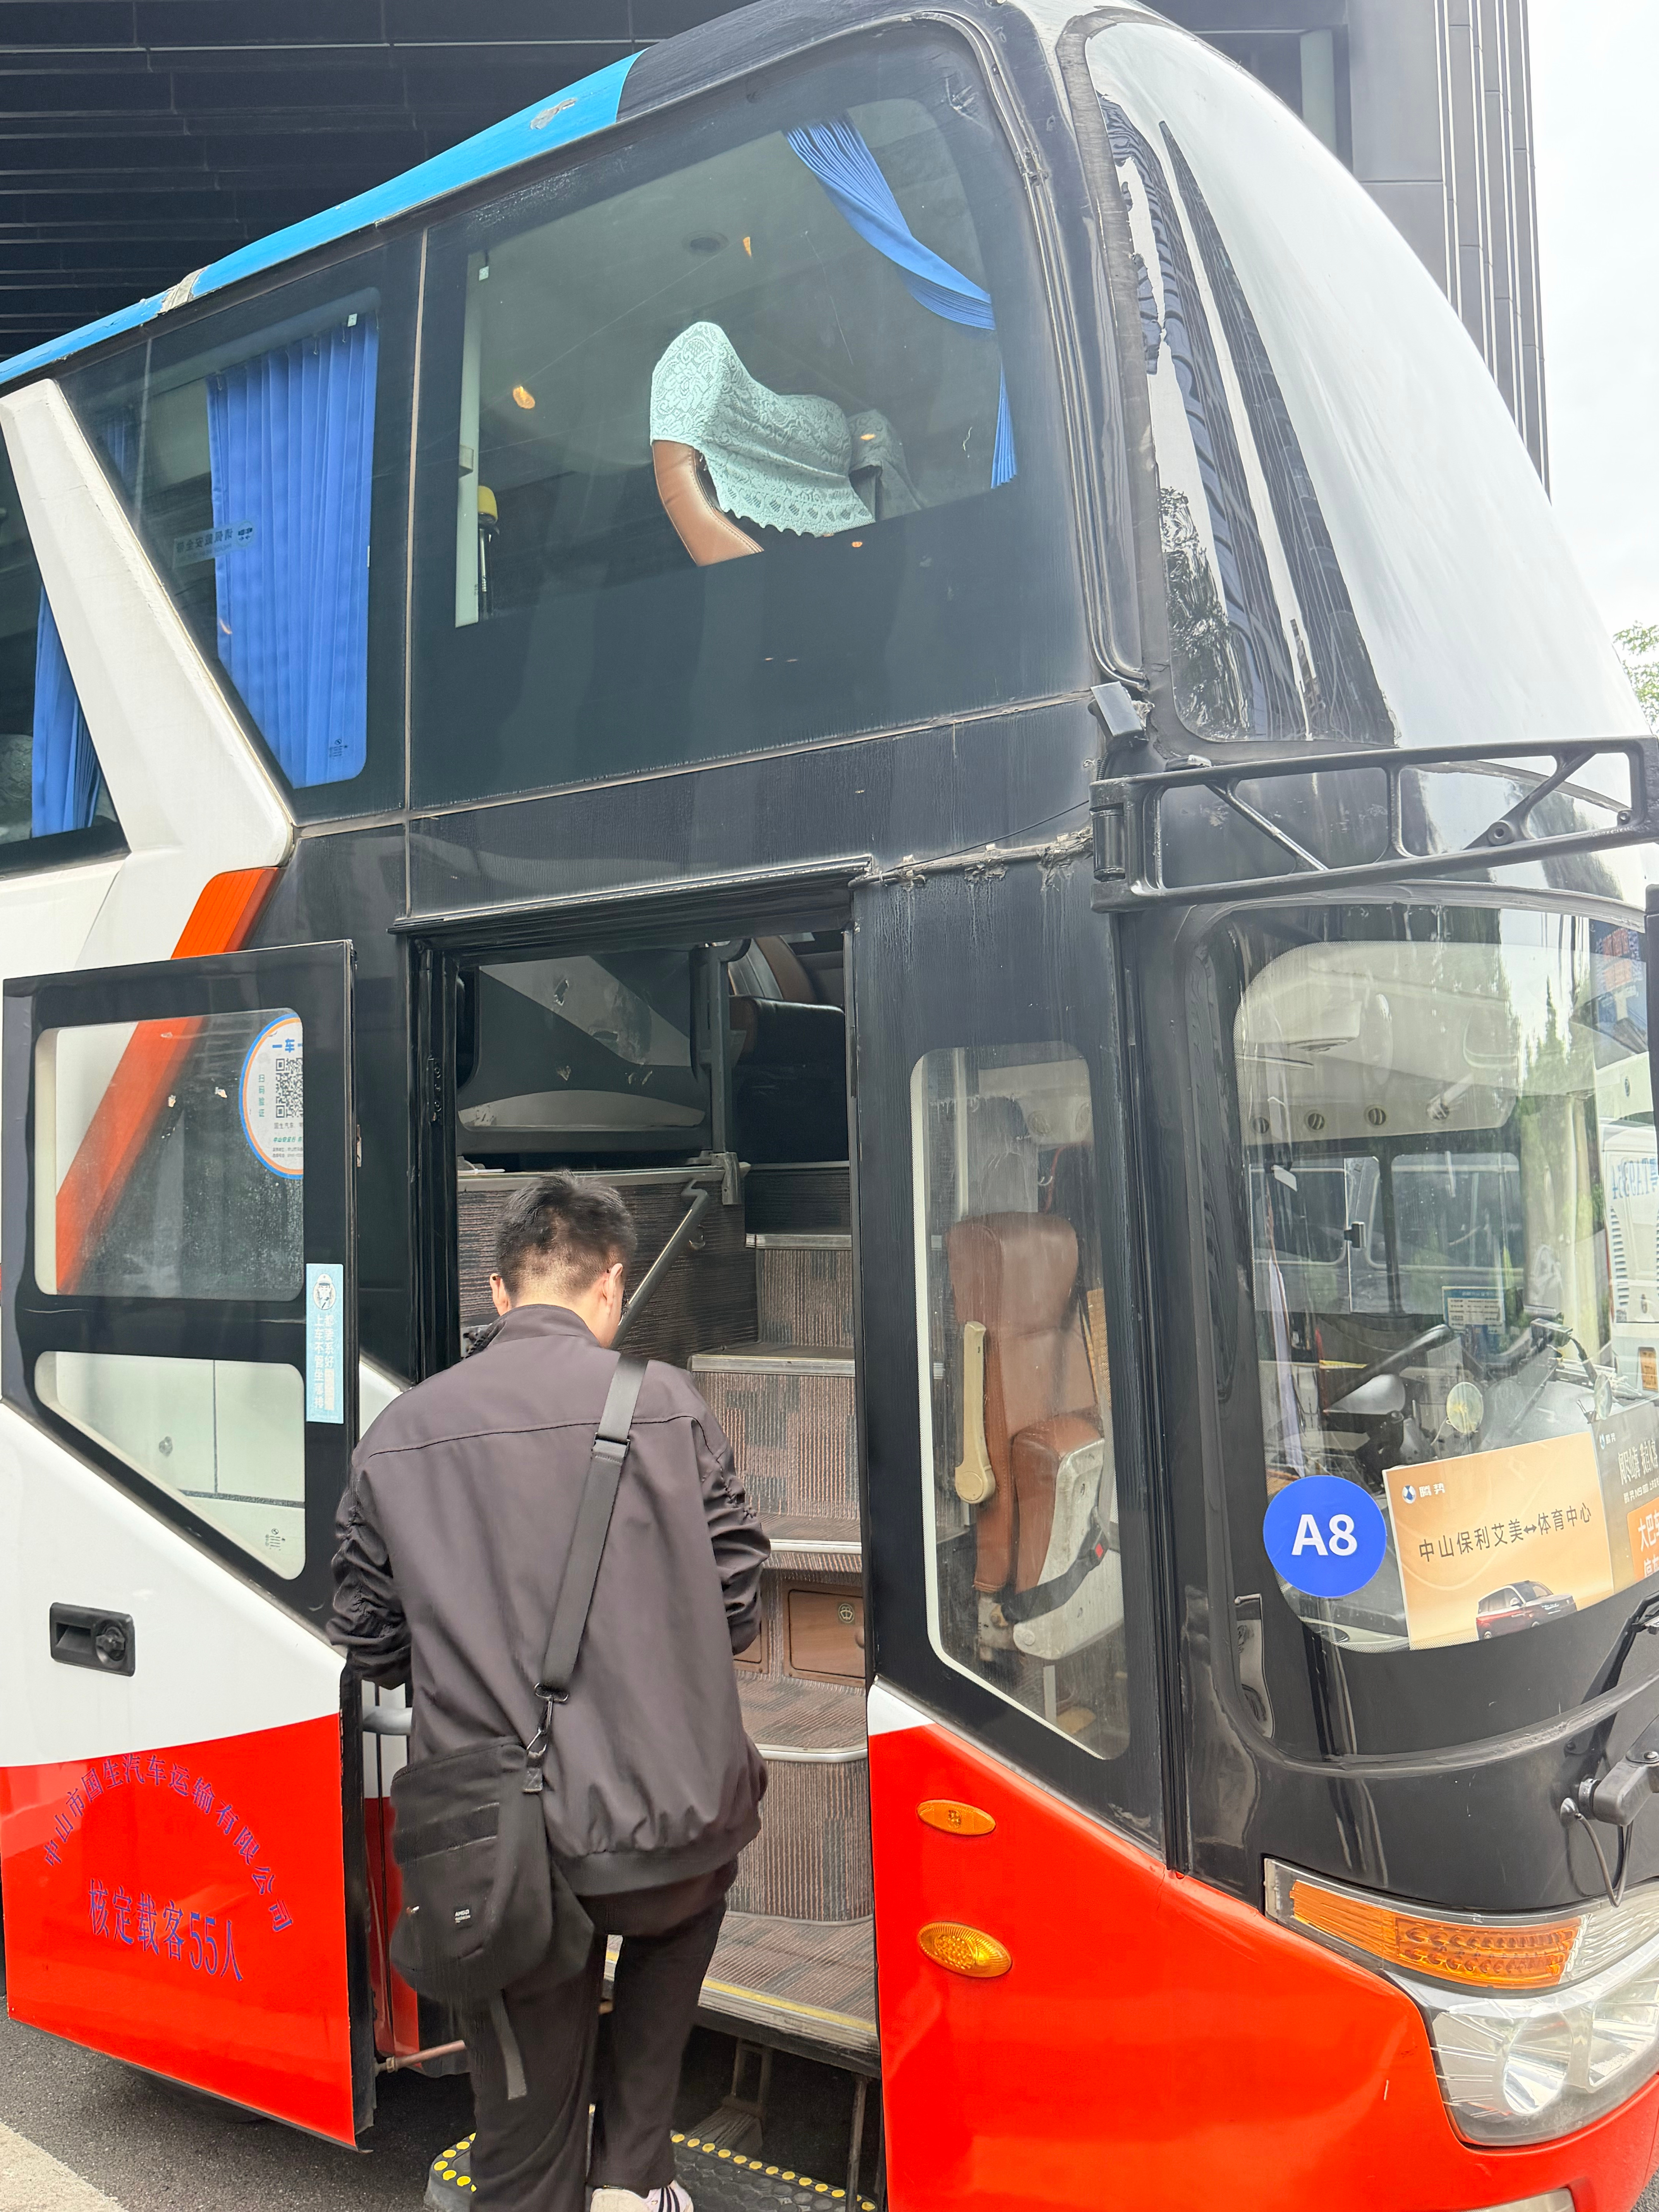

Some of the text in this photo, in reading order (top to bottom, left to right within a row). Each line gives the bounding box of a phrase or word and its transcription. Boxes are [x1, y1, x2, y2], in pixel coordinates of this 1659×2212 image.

[1419, 1483, 1445, 1498] 腾势
[1291, 1514, 1357, 1556] A8
[44, 1753, 292, 1932] 中山市国生汽车运输有限公司
[88, 1878, 243, 1982] 核定载客55人
